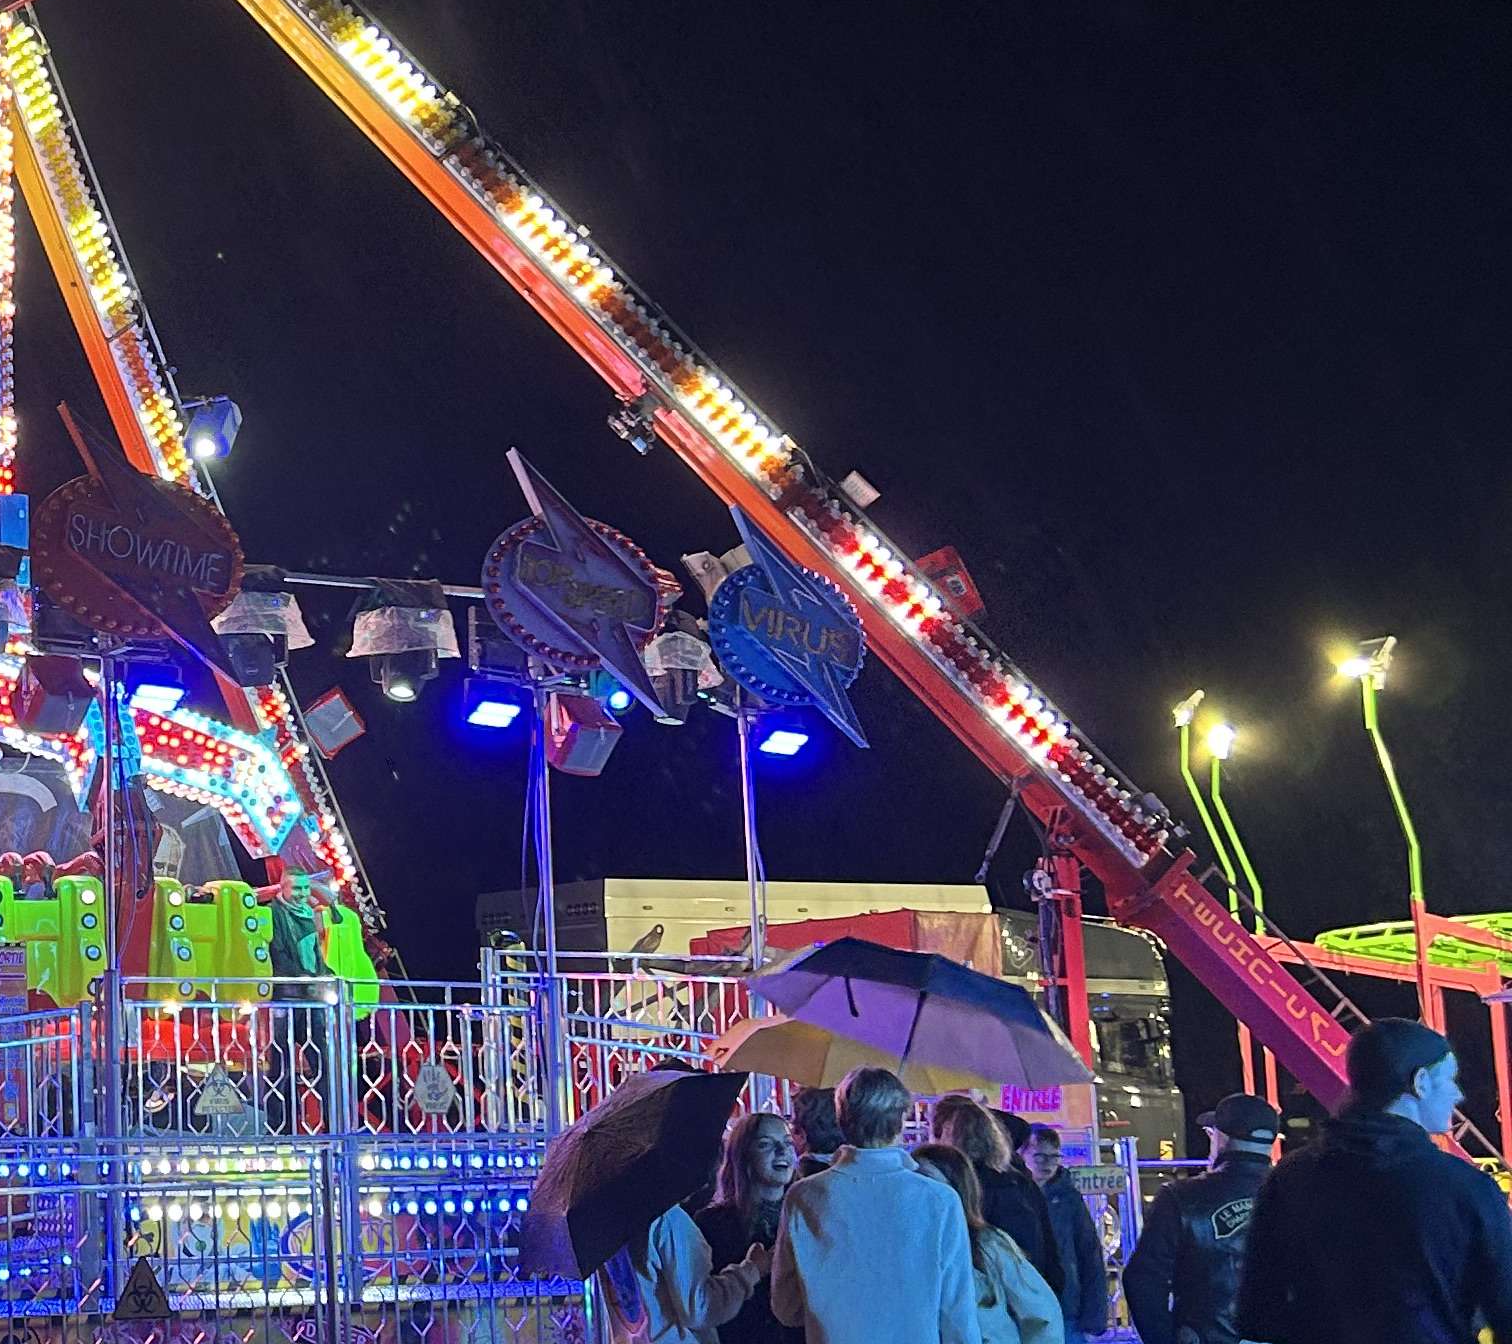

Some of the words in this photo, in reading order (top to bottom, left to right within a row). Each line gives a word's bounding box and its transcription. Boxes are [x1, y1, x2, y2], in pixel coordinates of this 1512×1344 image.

[70, 513, 224, 587] SHOWTIME
[743, 598, 851, 664] VIRUS
[1174, 882, 1347, 1057] TECHNICAL
